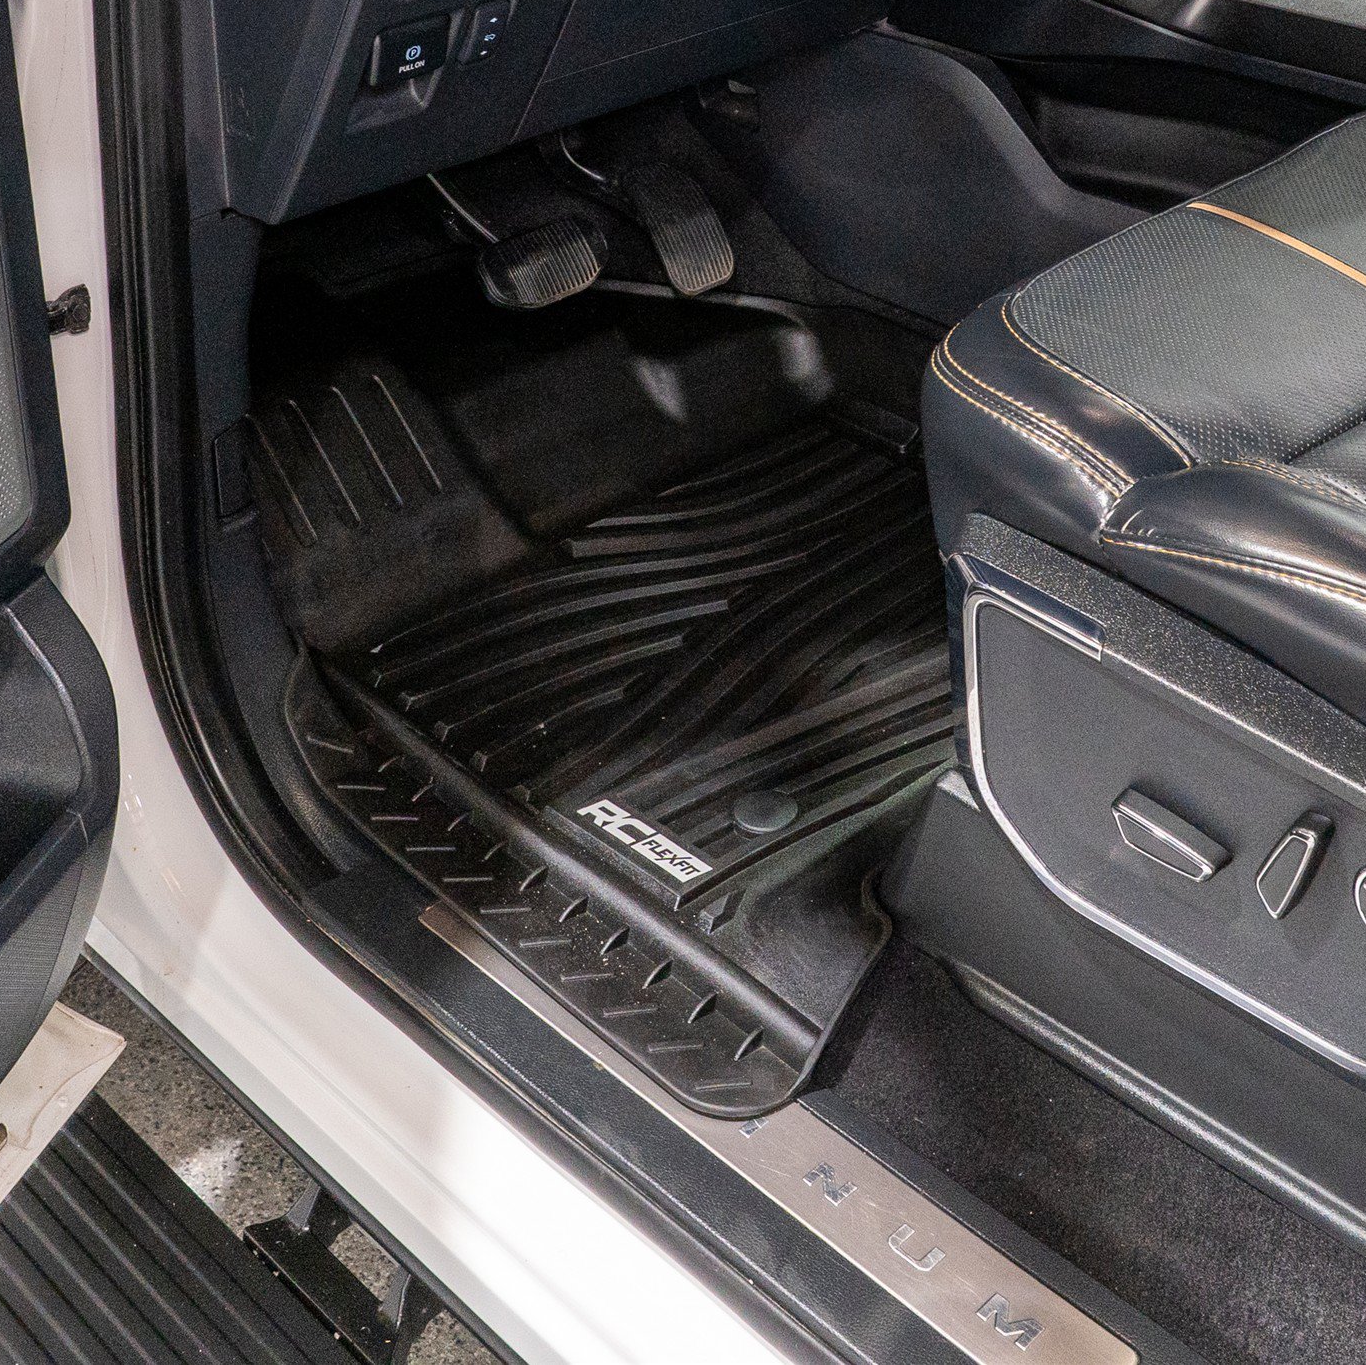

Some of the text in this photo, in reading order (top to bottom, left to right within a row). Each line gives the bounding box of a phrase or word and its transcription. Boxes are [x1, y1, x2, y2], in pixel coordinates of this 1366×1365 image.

[398, 60, 425, 73] PULL ON
[577, 799, 701, 876] RC FLEXFIT
[739, 1117, 1045, 1352] INUM
